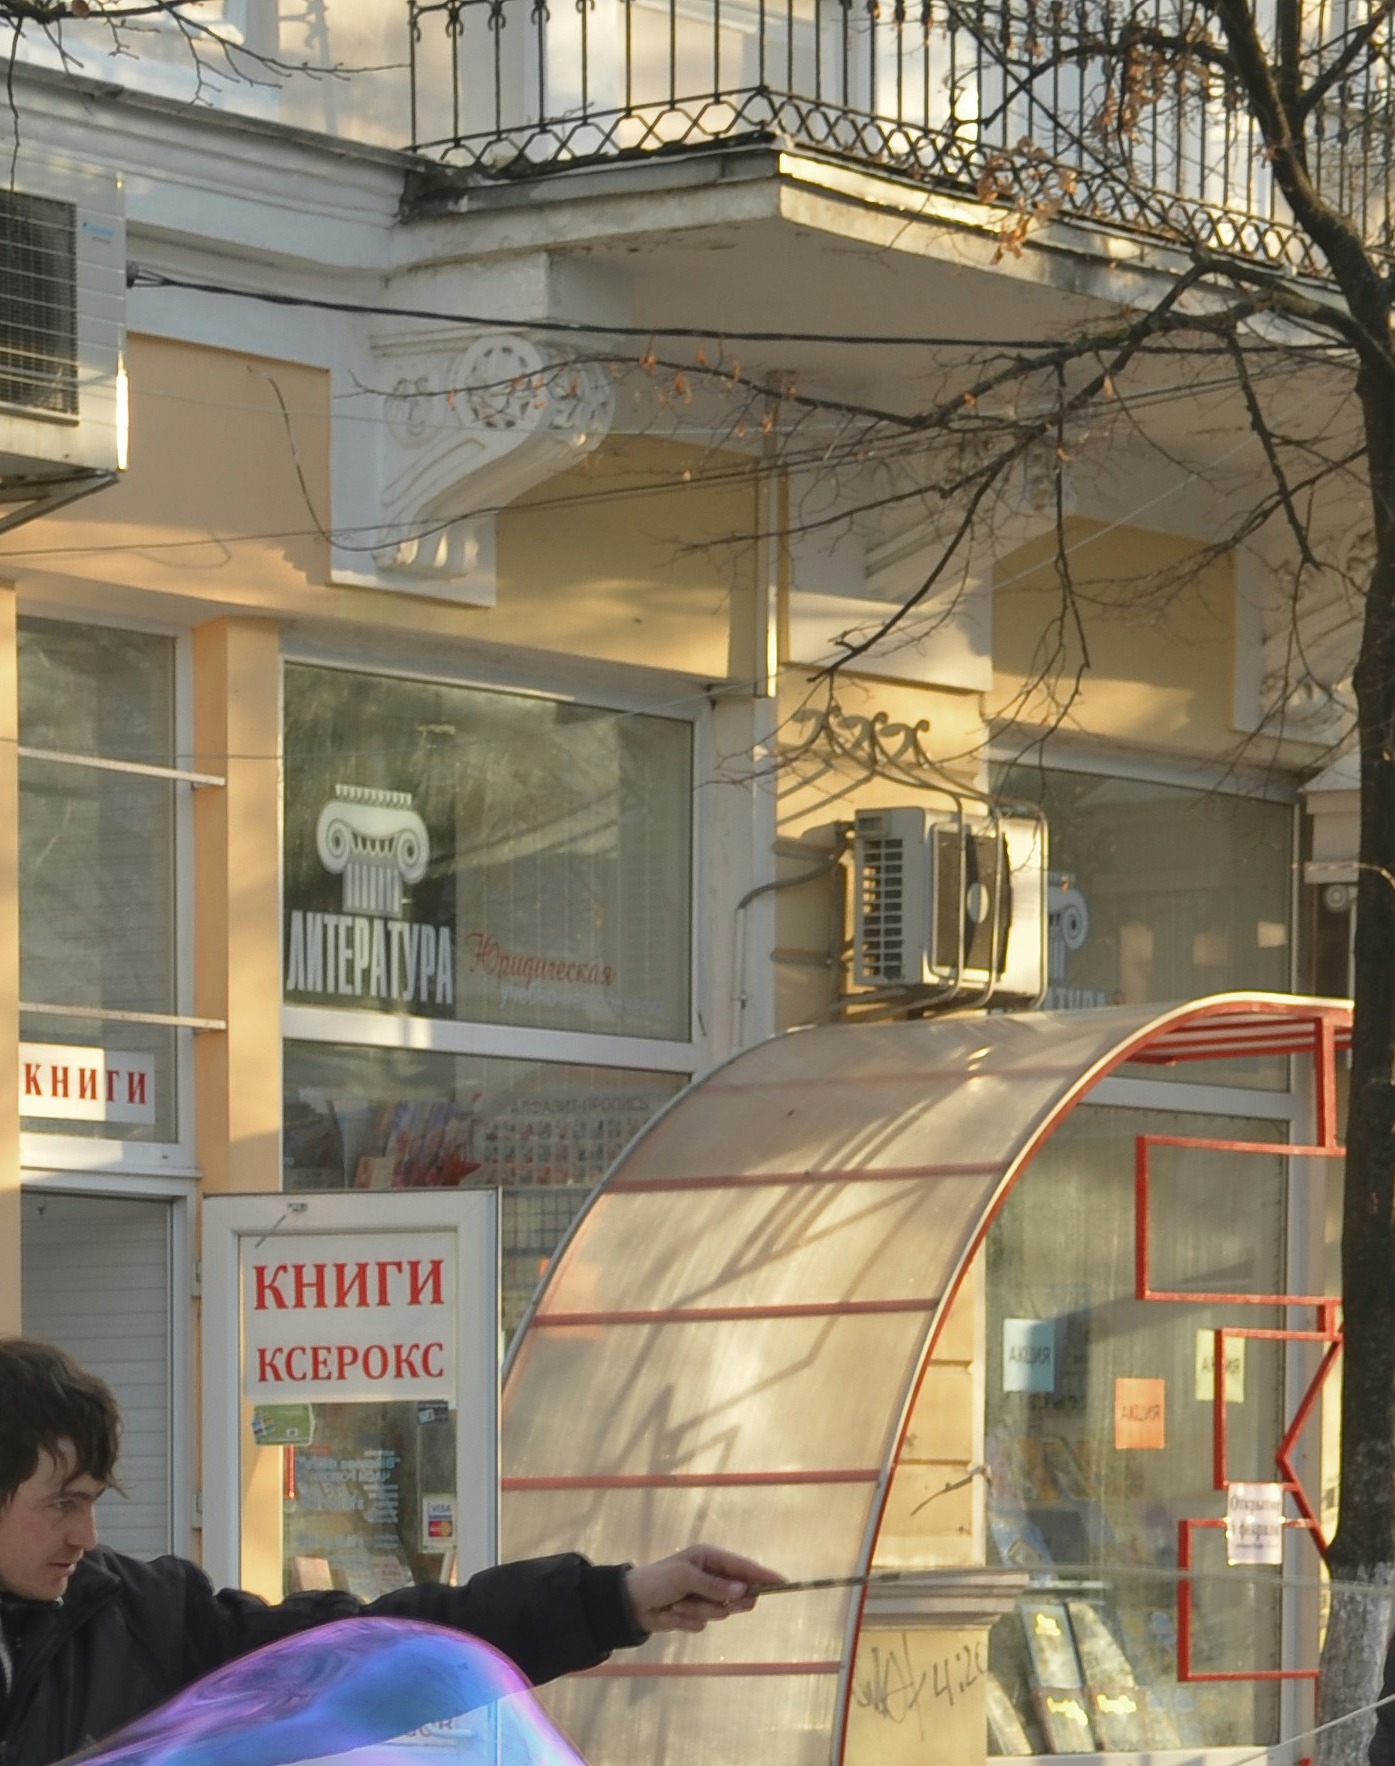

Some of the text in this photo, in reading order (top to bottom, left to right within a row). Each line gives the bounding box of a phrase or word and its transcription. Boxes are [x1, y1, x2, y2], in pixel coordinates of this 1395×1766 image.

[286, 909, 453, 1004] ЛИТЕРАТУРА
[466, 931, 615, 989] Юридическая
[24, 1062, 147, 1105] КНИГИ
[253, 1259, 445, 1310] КНИГИ
[257, 1342, 444, 1382] КСЕРОКС
